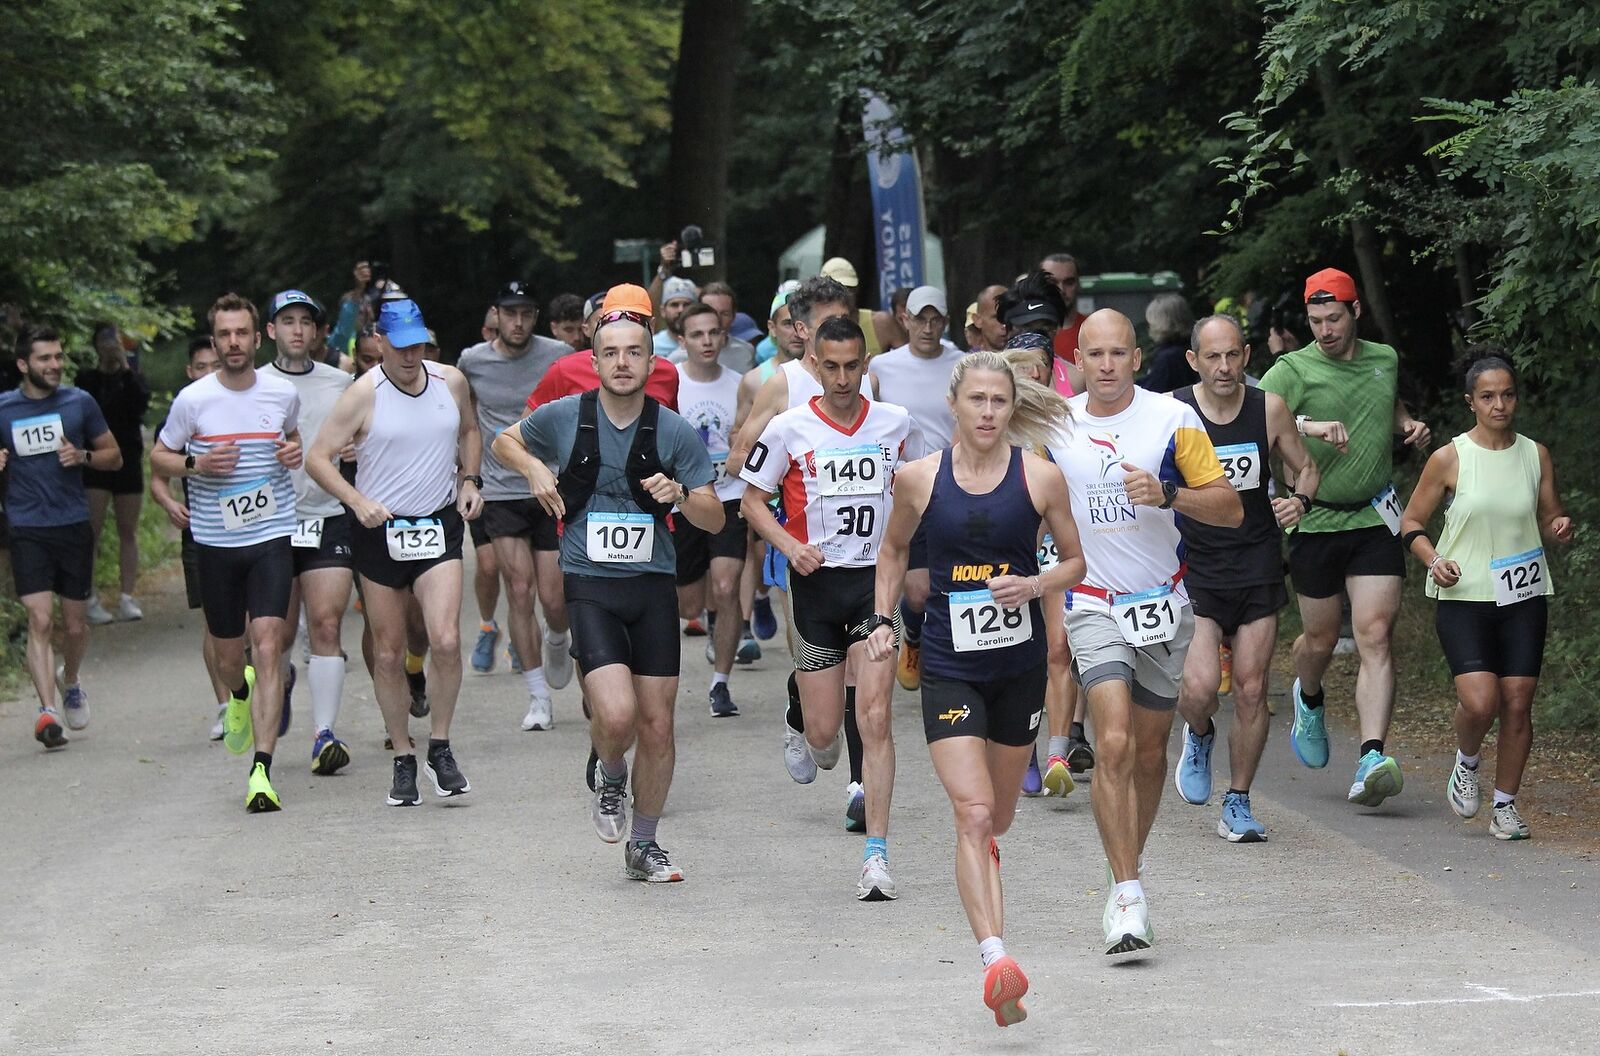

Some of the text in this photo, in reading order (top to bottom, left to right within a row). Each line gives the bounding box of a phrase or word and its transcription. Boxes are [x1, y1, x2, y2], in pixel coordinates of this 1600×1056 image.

[22, 425, 55, 445] 115
[824, 457, 876, 482] 140
[1219, 456, 1252, 480] 39
[1087, 487, 1126, 495] ONENESS-HO
[227, 490, 268, 517] 126
[1089, 505, 1137, 524] RUN
[1386, 494, 1403, 517] 11
[836, 505, 875, 537] 30
[1093, 524, 1140, 534] peacerun.org
[394, 528, 439, 550] 132
[596, 526, 647, 549] 107
[400, 550, 436, 559] Christophe
[952, 563, 1010, 581] HOUR 7
[1500, 561, 1541, 591] 122
[960, 605, 1022, 634] 128
[1123, 599, 1175, 632] 131
[977, 635, 1015, 647] Caroline
[1142, 632, 1167, 643] Lionel
